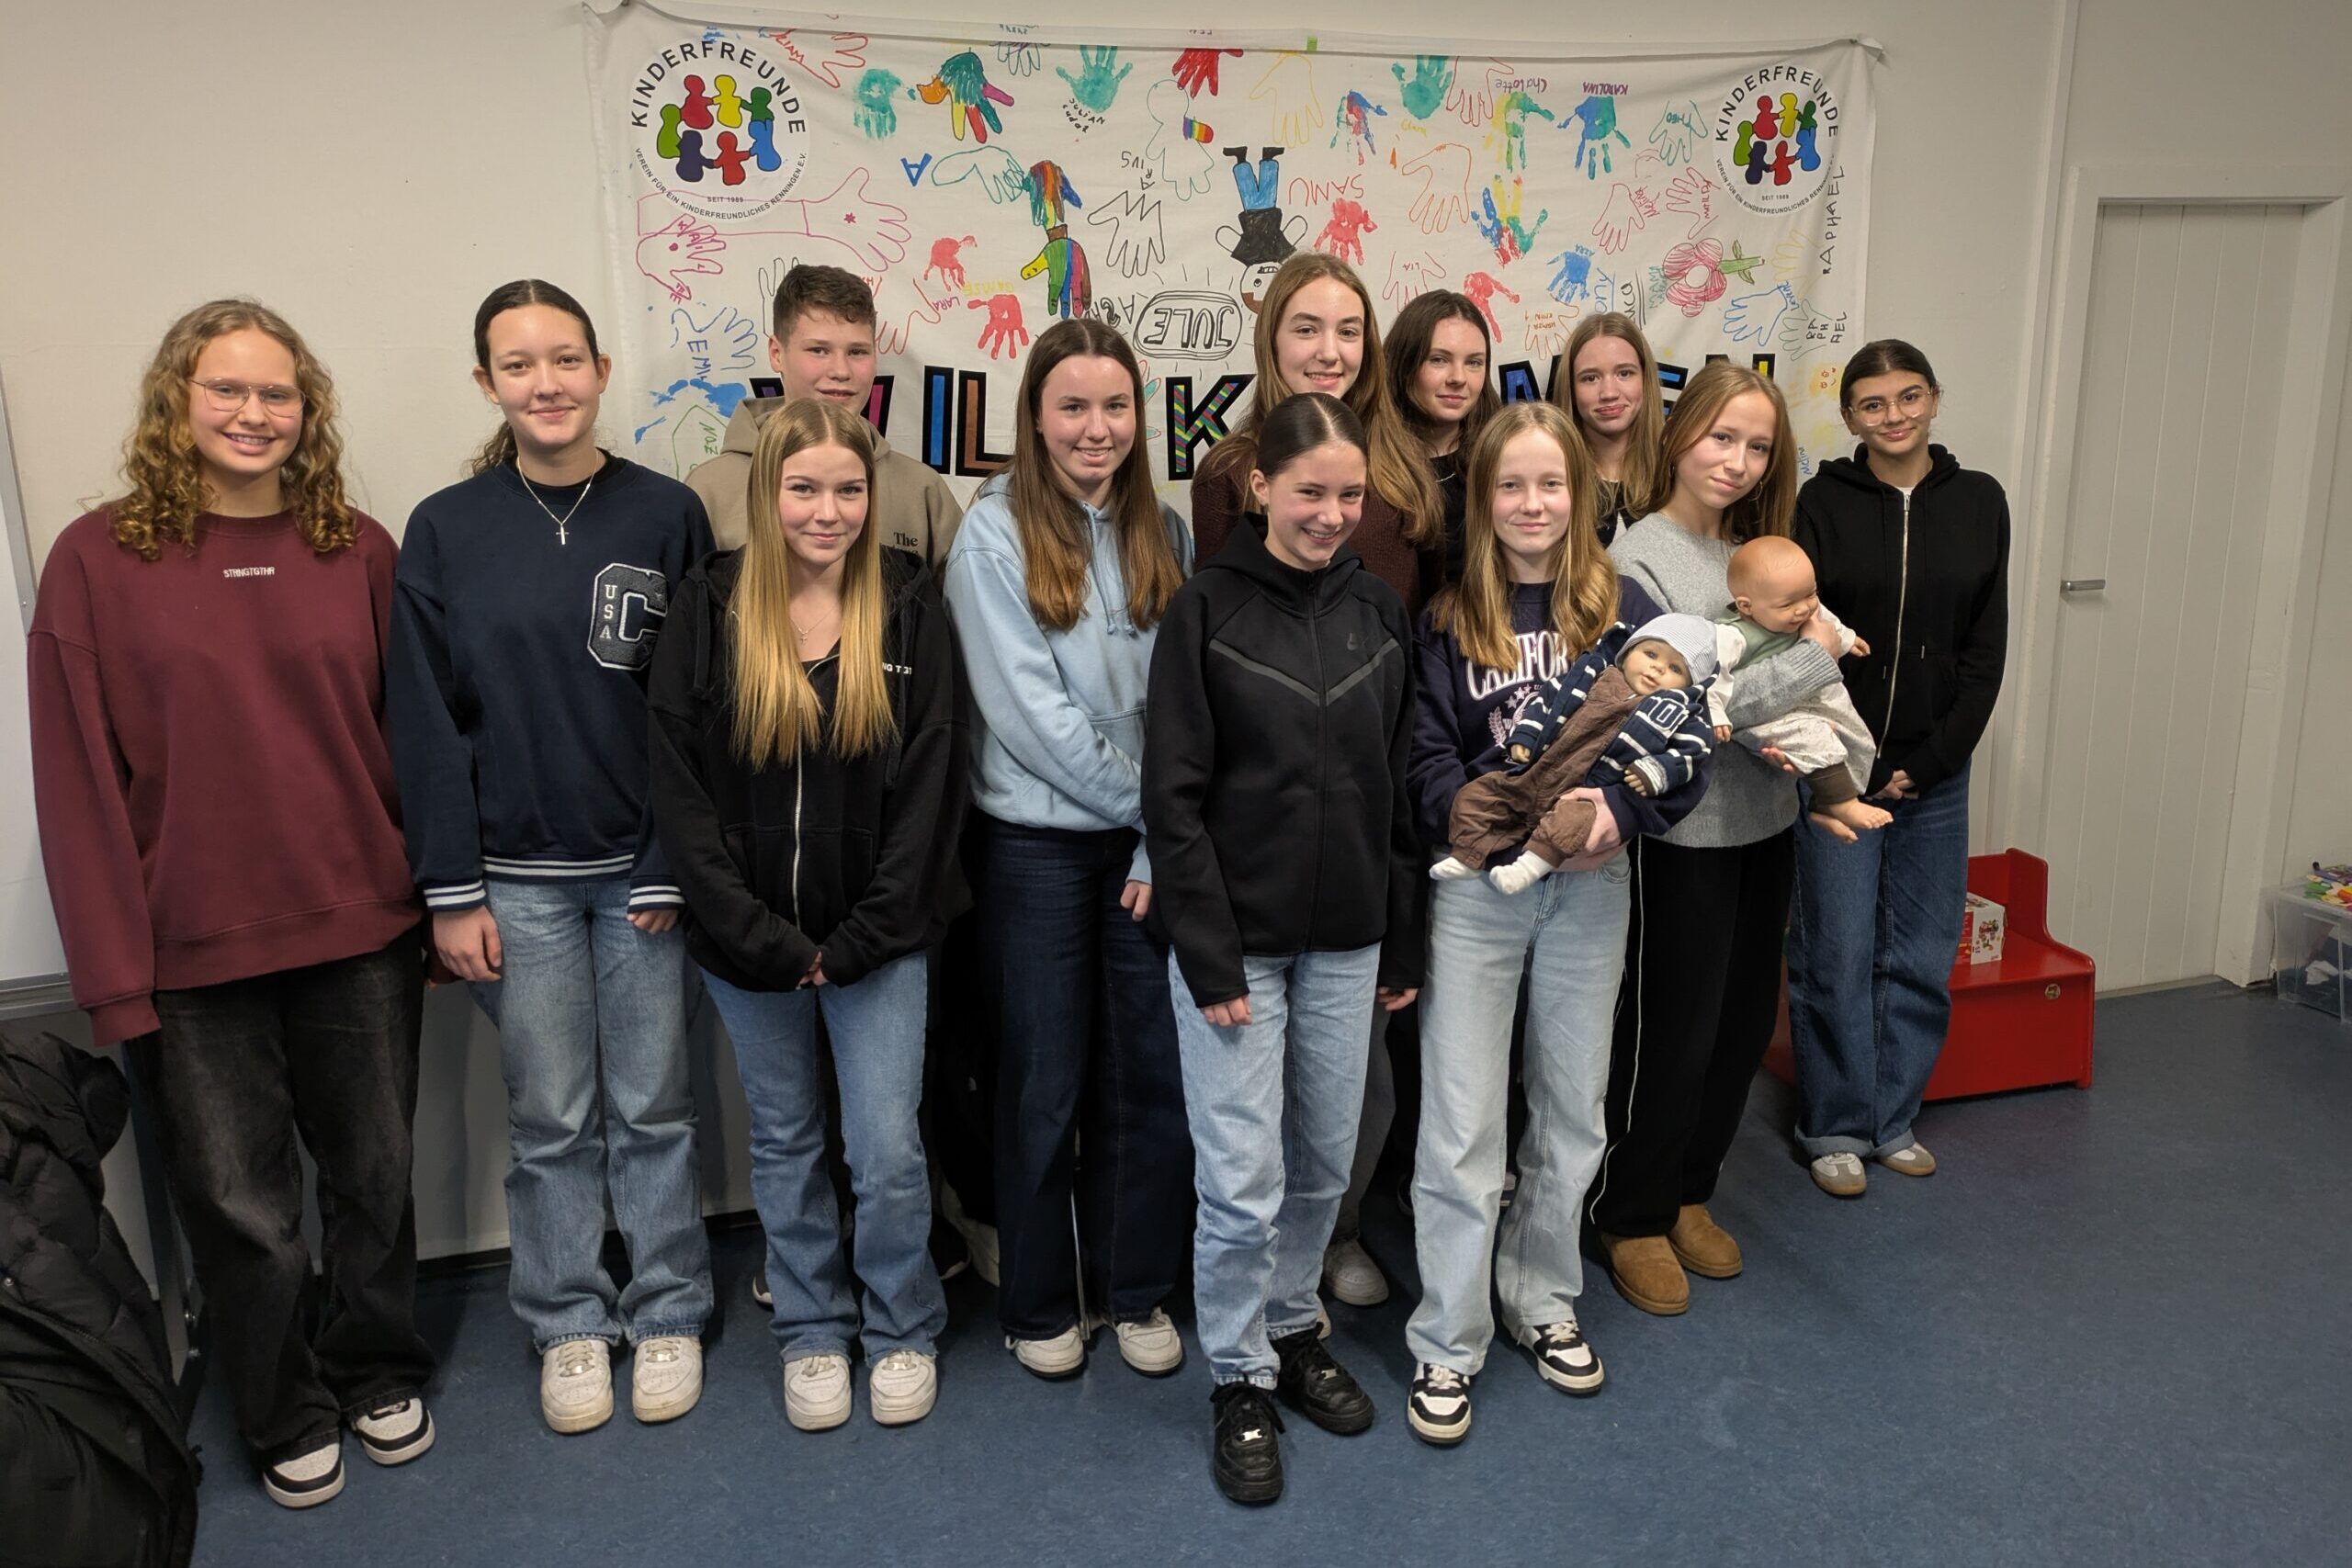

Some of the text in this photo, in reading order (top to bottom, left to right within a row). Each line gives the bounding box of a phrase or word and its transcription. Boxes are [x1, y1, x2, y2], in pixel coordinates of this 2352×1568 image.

[631, 40, 806, 134] KINDERFREUNDE
[1715, 65, 1838, 141] KINDERFREUNDE
[635, 147, 652, 179] VEREIN
[652, 177, 667, 194] FÜR
[666, 190, 679, 205] EIN
[680, 200, 771, 220] KINDERFREUNDLICHES
[1819, 165, 1846, 276] RAPHAEL
[932, 296, 960, 311] LARA
[1143, 306, 1237, 350] JULE
[893, 531, 919, 547] The
